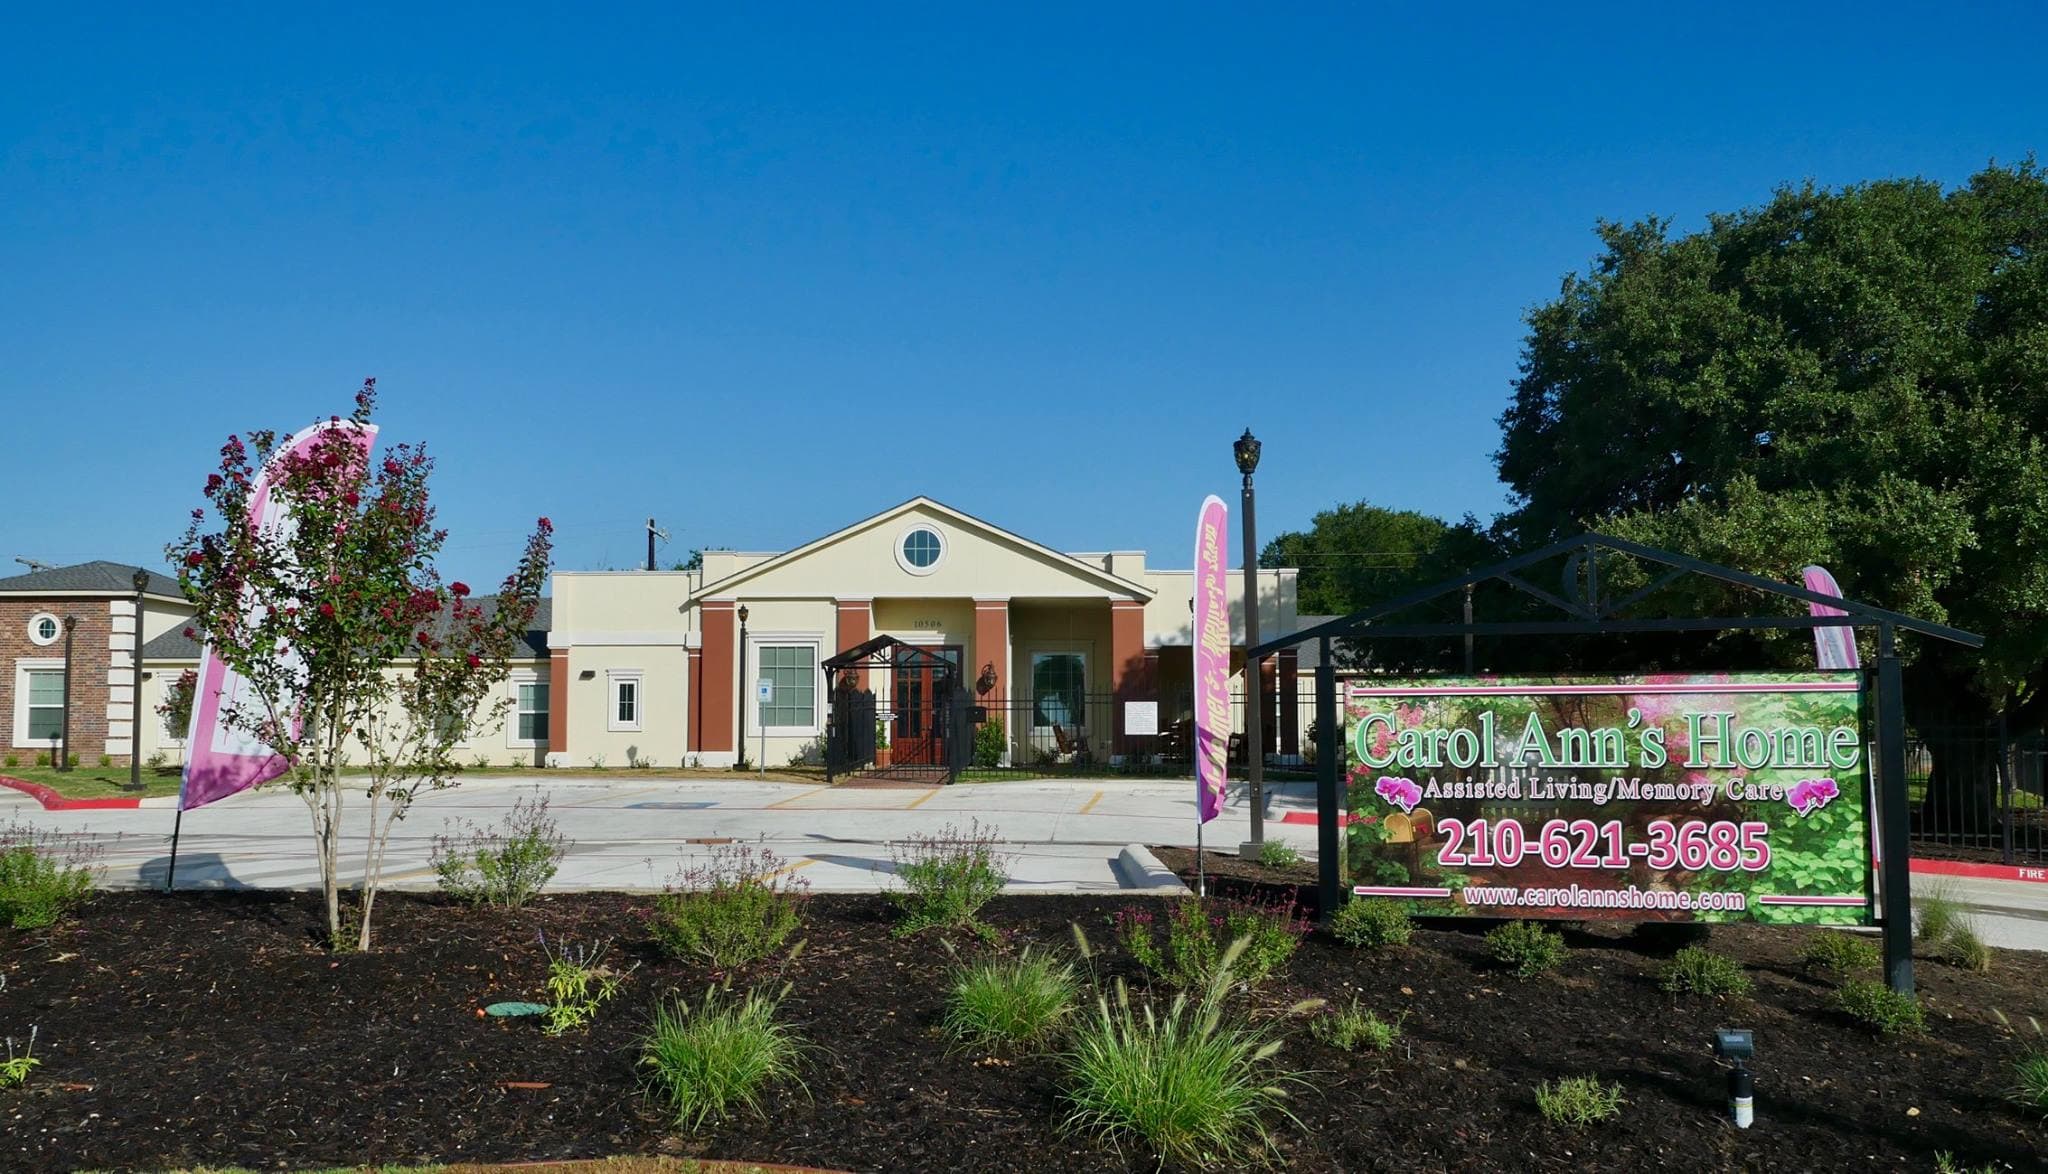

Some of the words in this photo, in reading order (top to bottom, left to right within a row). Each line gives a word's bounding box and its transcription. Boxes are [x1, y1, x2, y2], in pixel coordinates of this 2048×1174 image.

[914, 620, 942, 629] 10506
[1355, 711, 1499, 769] Carol
[1509, 708, 1667, 769] Ann's
[1683, 711, 1859, 769] Home
[1423, 777, 1521, 799] Assisted
[1529, 777, 1717, 805] Living/Memory
[1725, 778, 1783, 800] Care
[1438, 818, 1771, 871] 210-621-3685
[2019, 868, 2046, 880] FIRE
[1464, 884, 1745, 911] www.carolannshome.com
